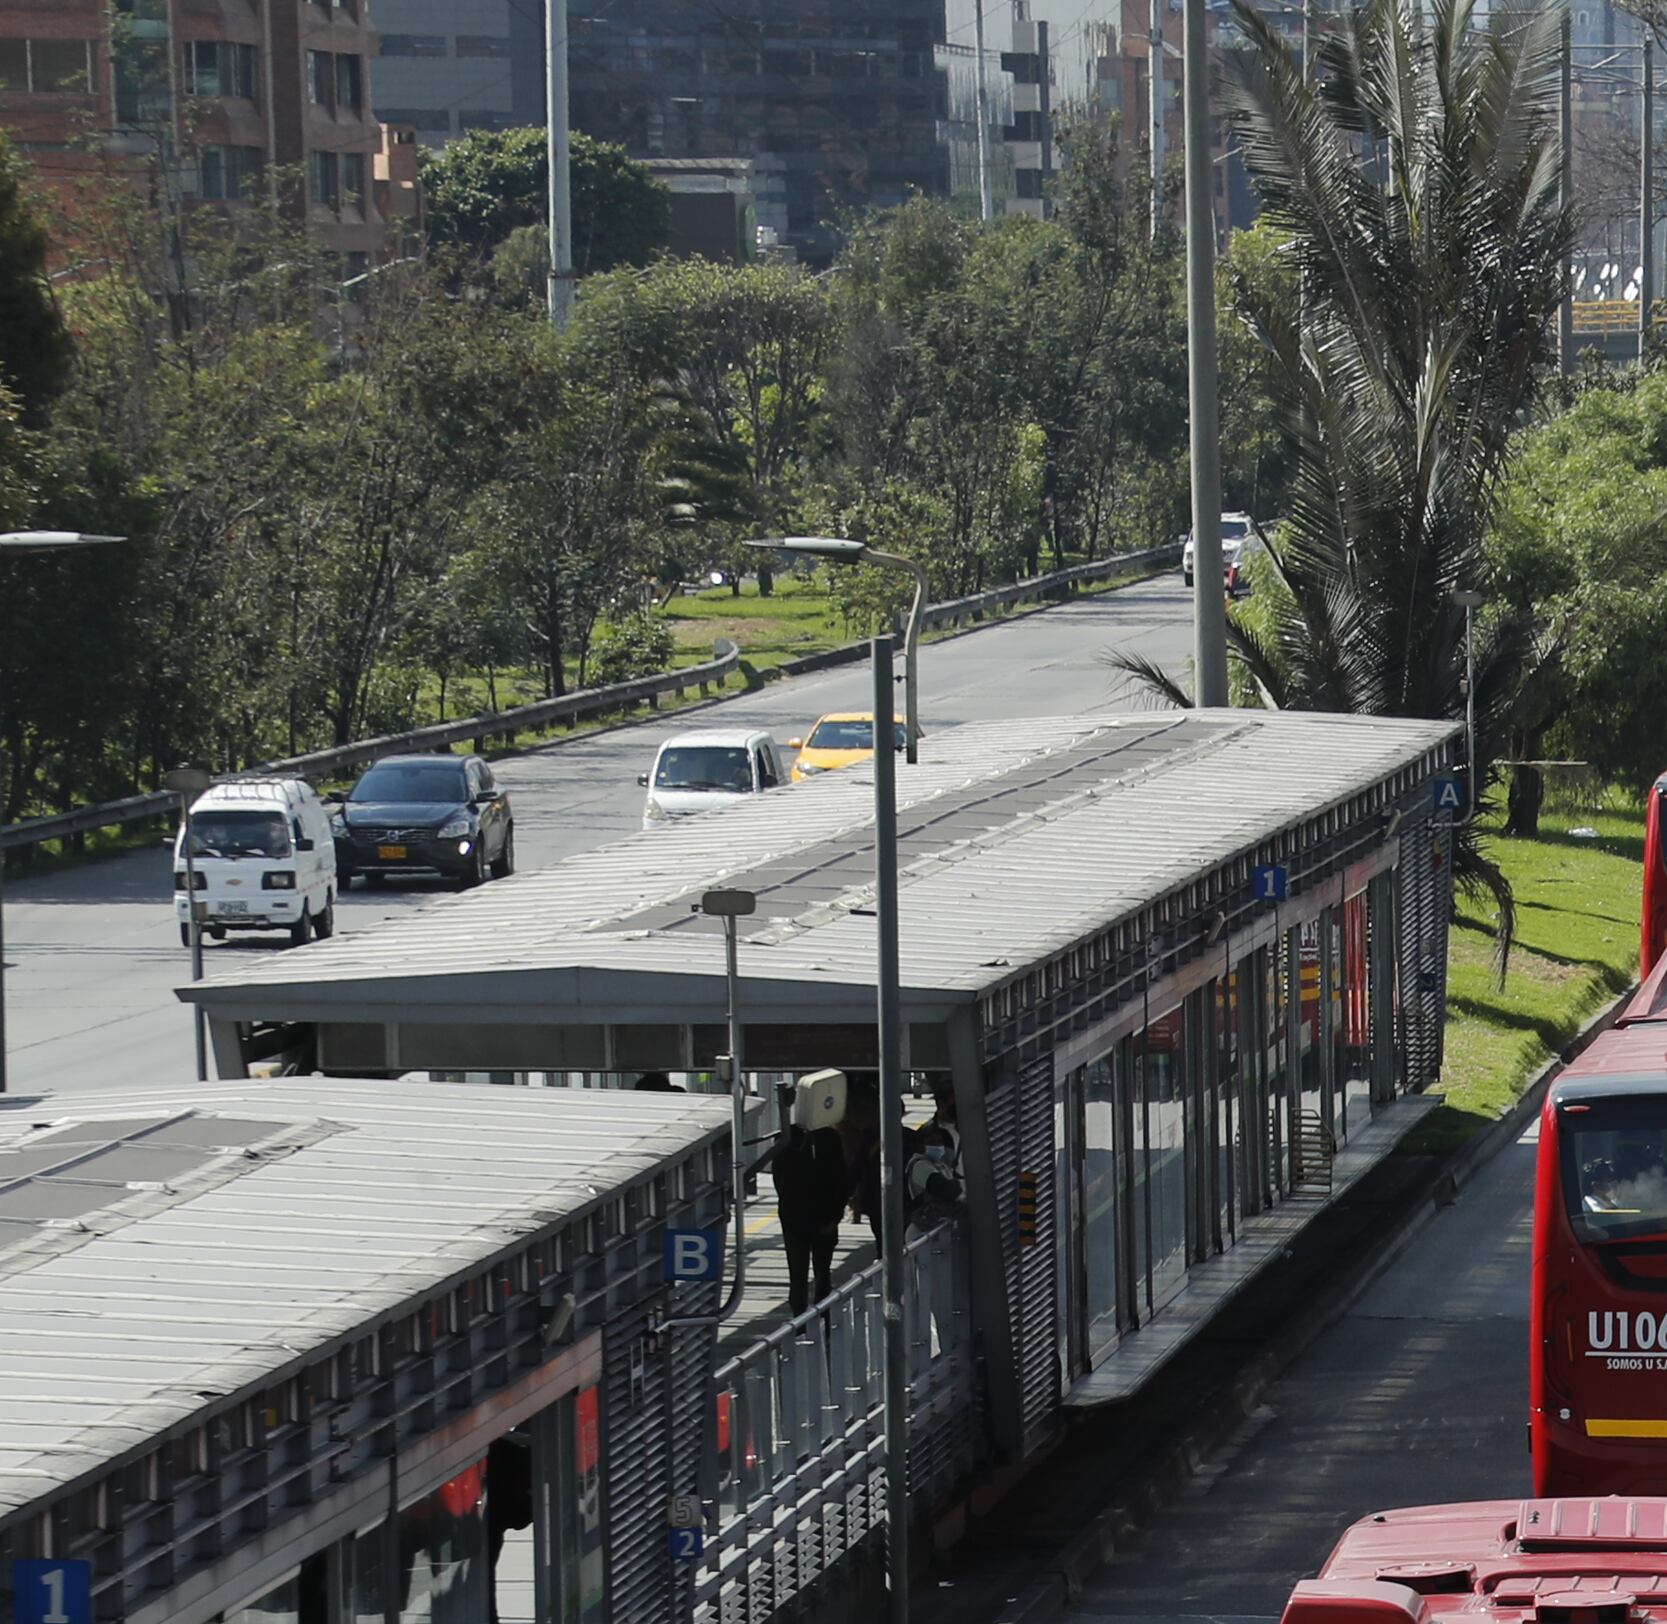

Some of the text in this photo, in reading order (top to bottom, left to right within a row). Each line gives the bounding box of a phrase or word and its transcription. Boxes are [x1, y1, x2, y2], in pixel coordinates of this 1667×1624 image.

[1439, 783, 1459, 807] A
[1264, 870, 1277, 897] 1
[673, 1234, 711, 1276] B
[1606, 1358, 1643, 1370] SOMOS
[1645, 1358, 1654, 1370] U
[674, 1497, 692, 1523] 5
[679, 1531, 696, 1557] 2
[40, 1568, 70, 1624] 1
